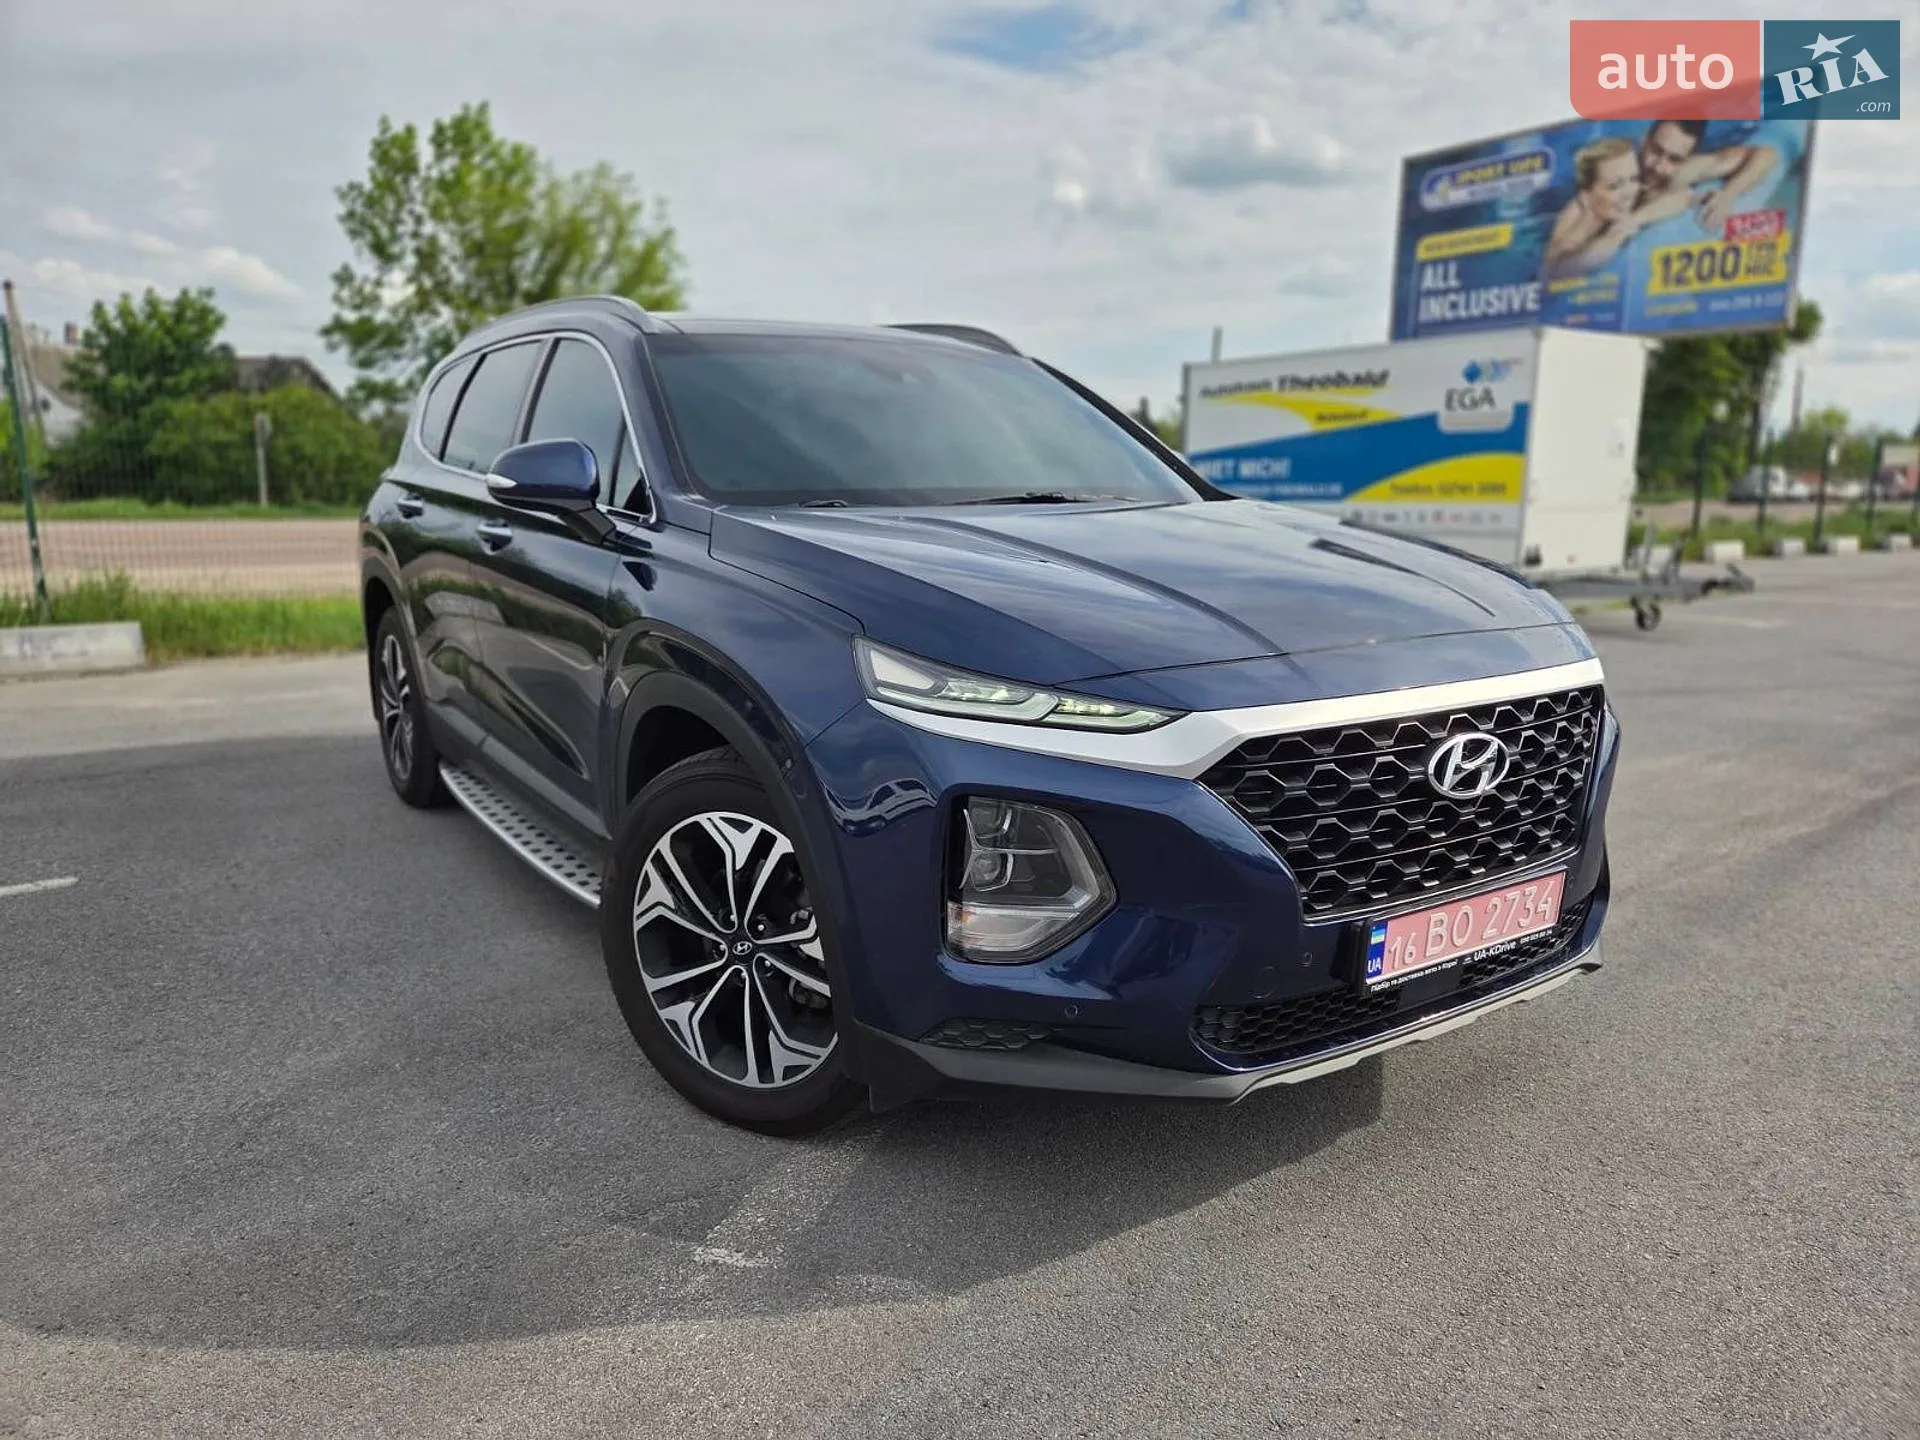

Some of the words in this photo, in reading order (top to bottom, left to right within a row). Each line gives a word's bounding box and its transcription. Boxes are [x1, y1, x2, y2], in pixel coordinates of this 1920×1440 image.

[1420, 260, 1460, 291] ALL
[1660, 244, 1742, 289] 1200
[1418, 281, 1542, 322] INCLUSIVE
[1444, 385, 1497, 412] EGA
[1389, 931, 1417, 970] 16
[1424, 905, 1475, 957] BO
[1482, 880, 1556, 941] 2734
[1367, 956, 1382, 974] UA
[1473, 940, 1517, 962] UA-KDrive
